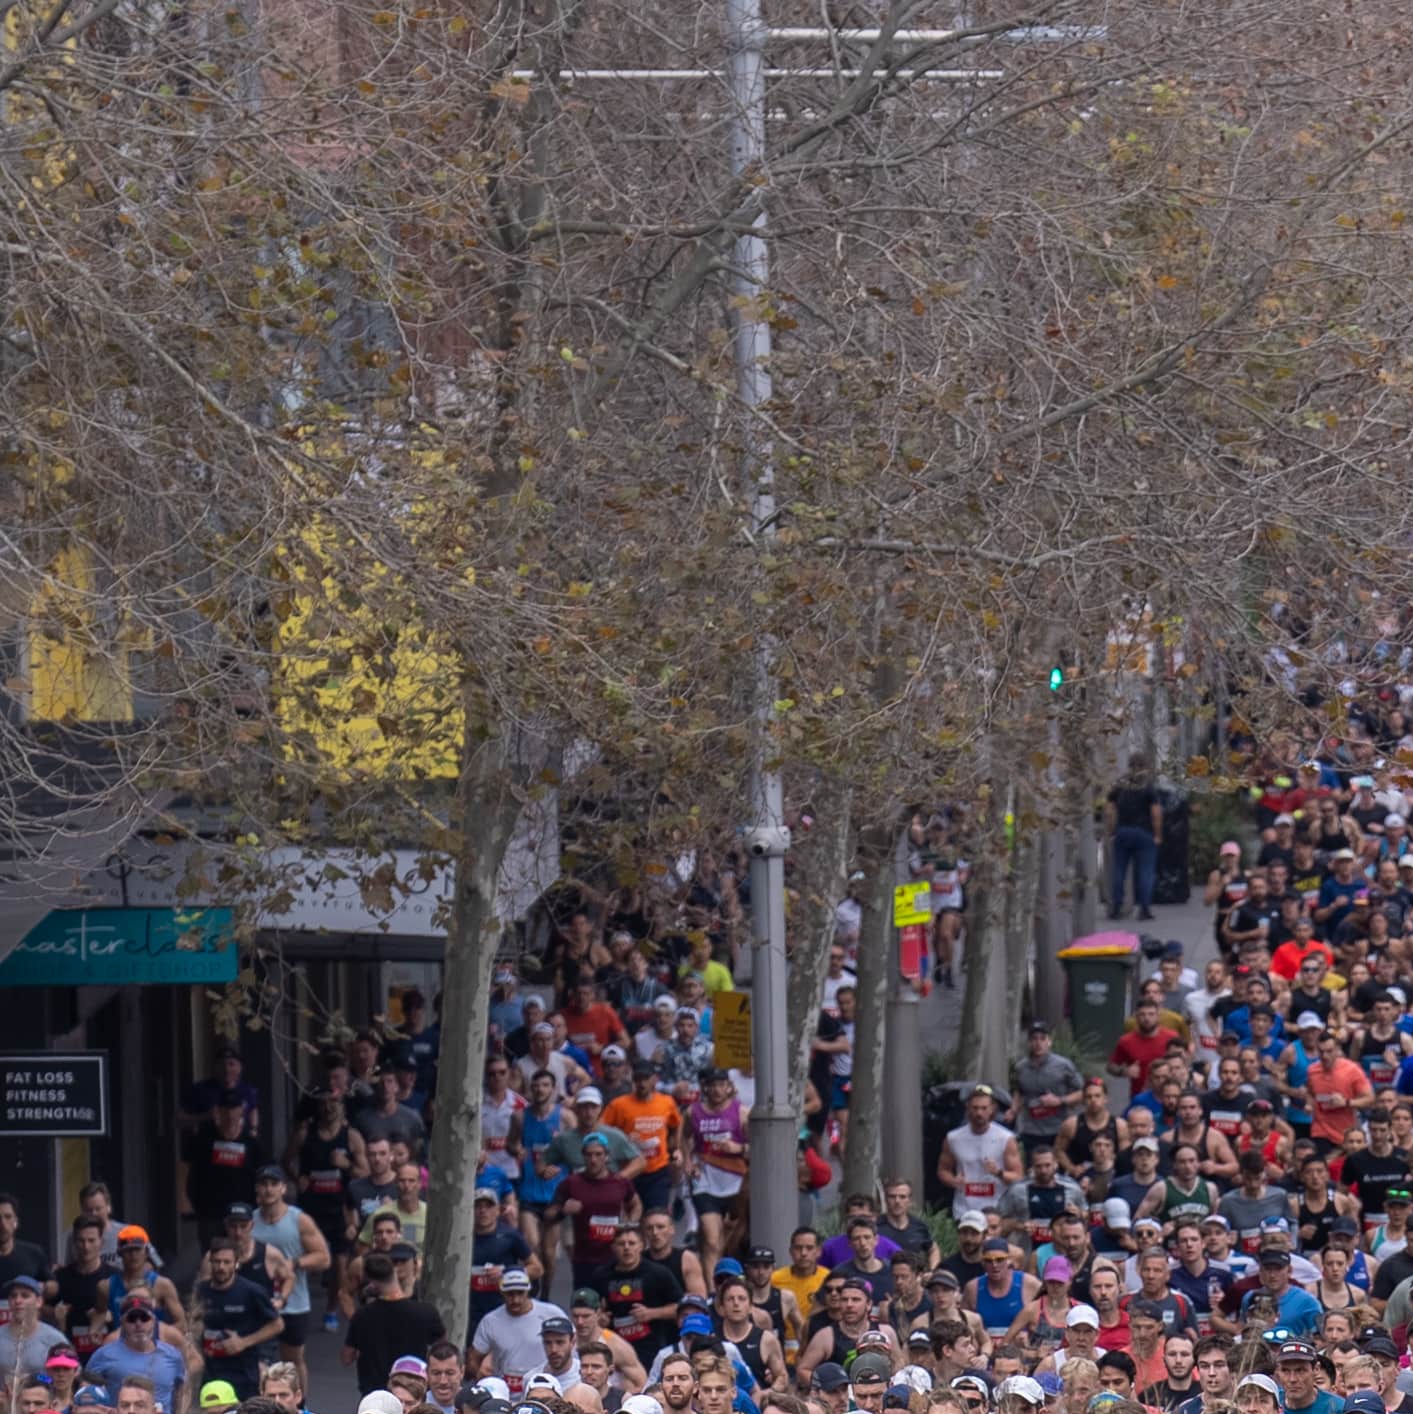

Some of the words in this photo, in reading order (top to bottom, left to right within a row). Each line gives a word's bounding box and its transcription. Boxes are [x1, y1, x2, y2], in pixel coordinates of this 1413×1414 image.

[6, 1072, 33, 1084] FAT
[37, 1072, 74, 1084] LOSS
[6, 1089, 67, 1102] FITNESS
